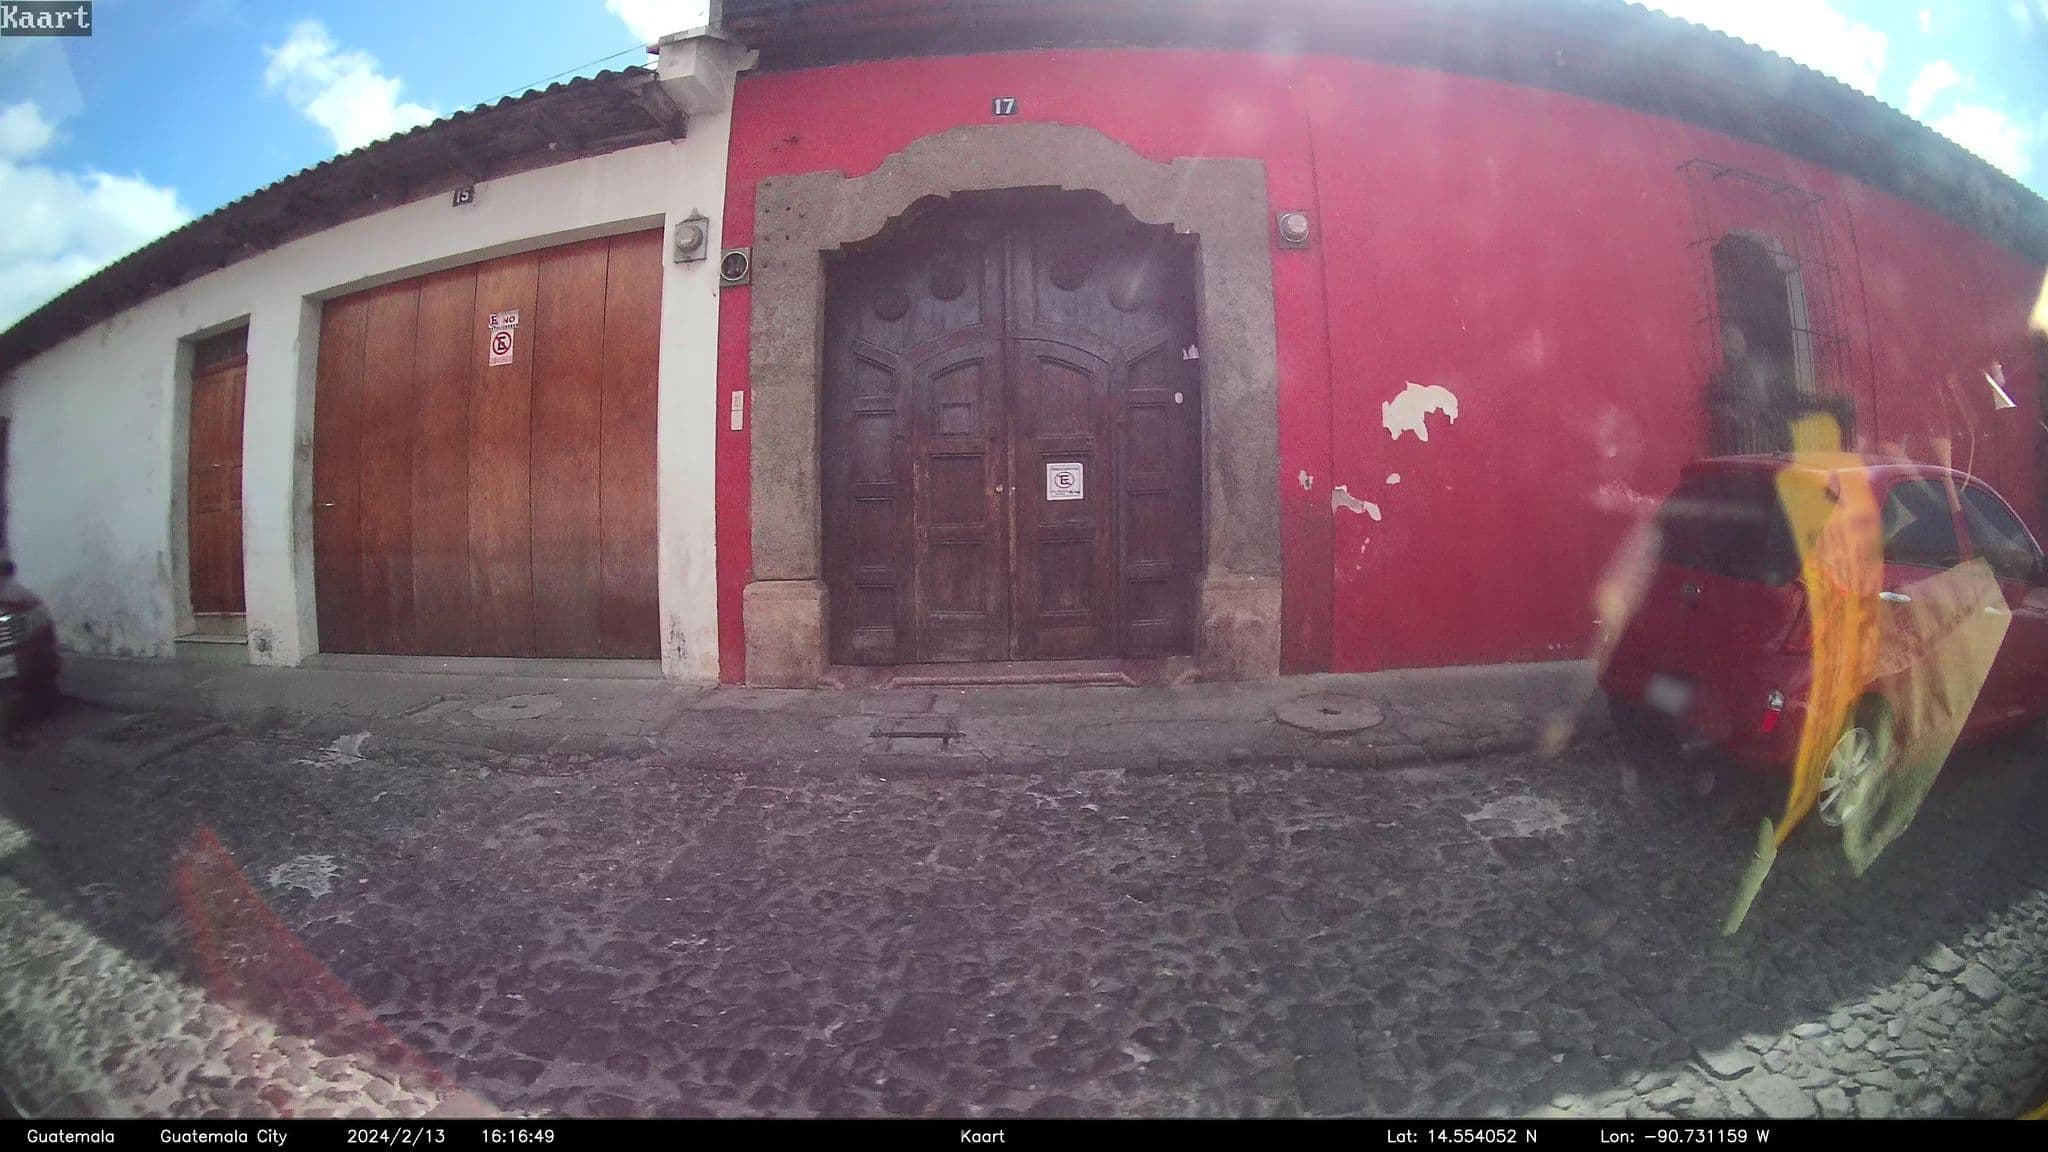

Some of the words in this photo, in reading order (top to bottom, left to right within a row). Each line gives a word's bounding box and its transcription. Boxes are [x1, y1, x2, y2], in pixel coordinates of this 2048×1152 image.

[995, 98, 1014, 114] 17
[457, 192, 469, 203] 15
[1060, 474, 1069, 485] E
